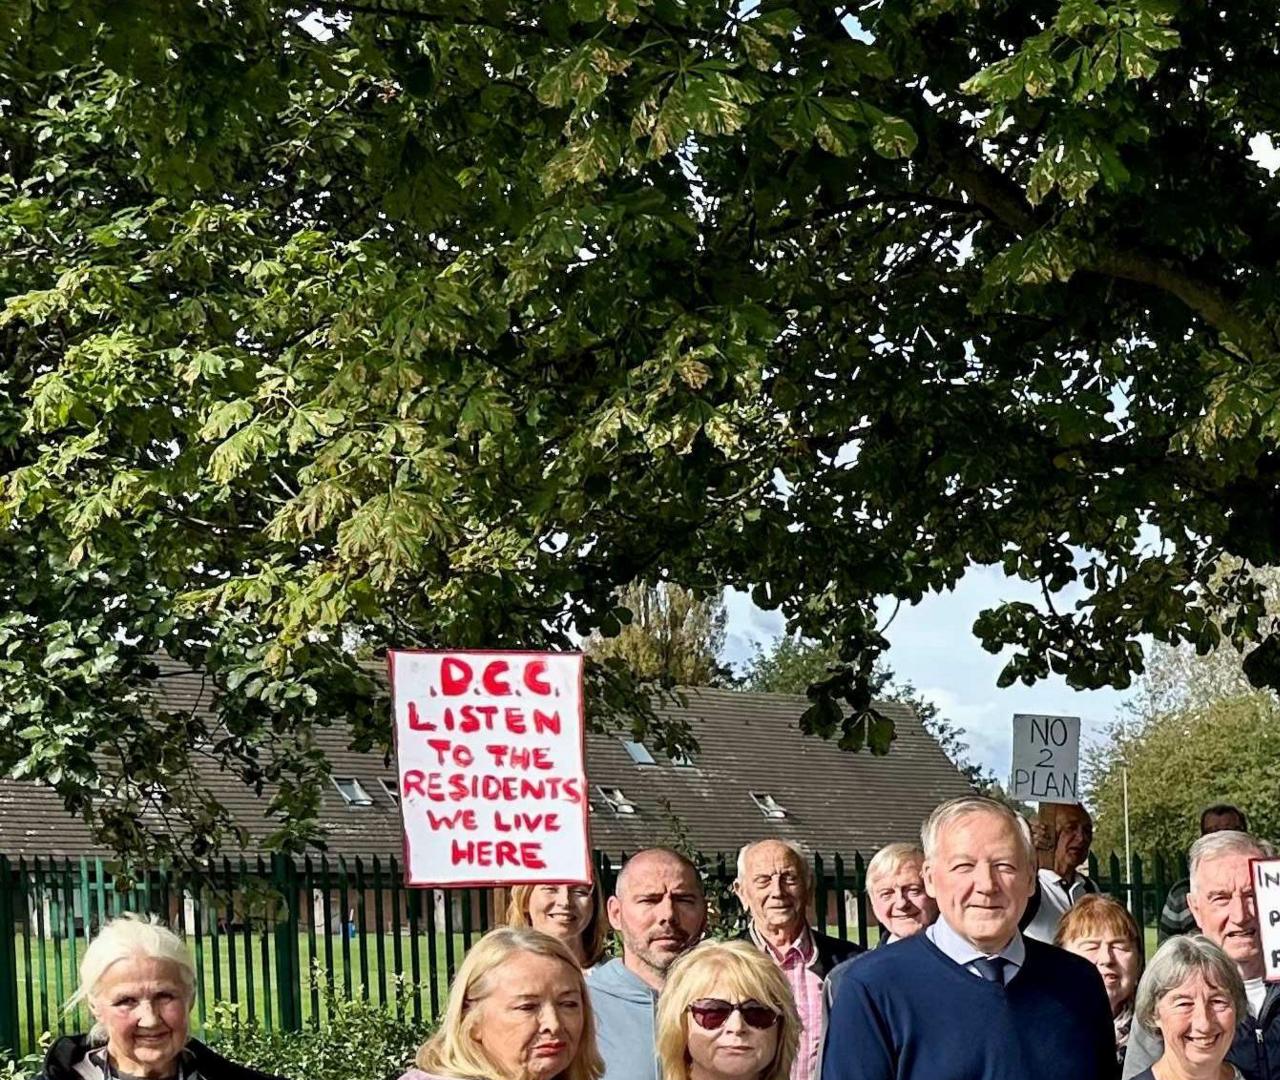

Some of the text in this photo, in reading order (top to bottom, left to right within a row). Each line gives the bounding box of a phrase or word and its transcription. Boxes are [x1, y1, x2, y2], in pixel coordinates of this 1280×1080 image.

[408, 701, 561, 735] LISTEN
[1031, 718, 1067, 746] NO
[427, 739, 555, 770] TO THE
[1035, 748, 1054, 768] 2
[403, 769, 581, 803] RESIDENTS
[1015, 769, 1077, 798] PLAN
[427, 809, 561, 832] WE LIVE
[451, 839, 547, 869] HERE
